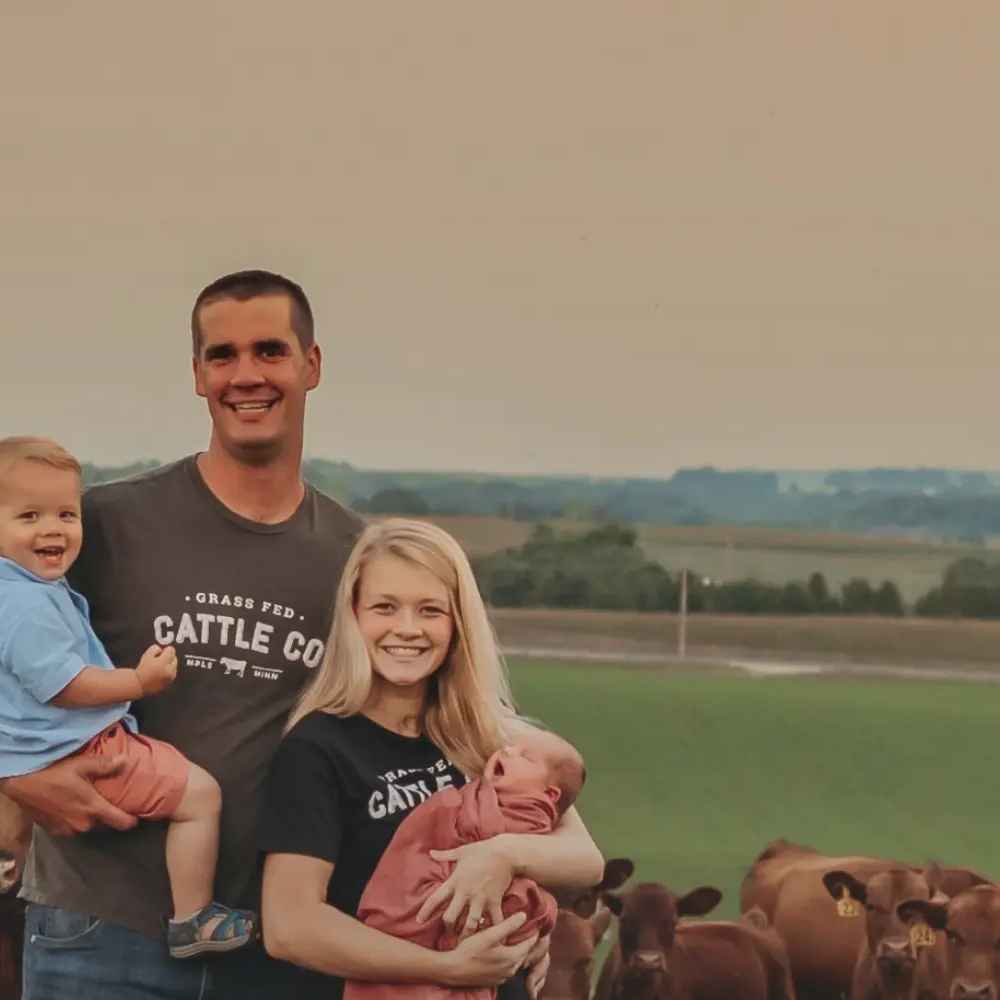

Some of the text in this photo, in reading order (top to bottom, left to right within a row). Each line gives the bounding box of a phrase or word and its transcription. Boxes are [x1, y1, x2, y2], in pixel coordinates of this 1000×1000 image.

[195, 592, 296, 619] GRASS FED
[153, 612, 326, 669] CATTLE CO
[186, 658, 280, 681] MPLS MINN
